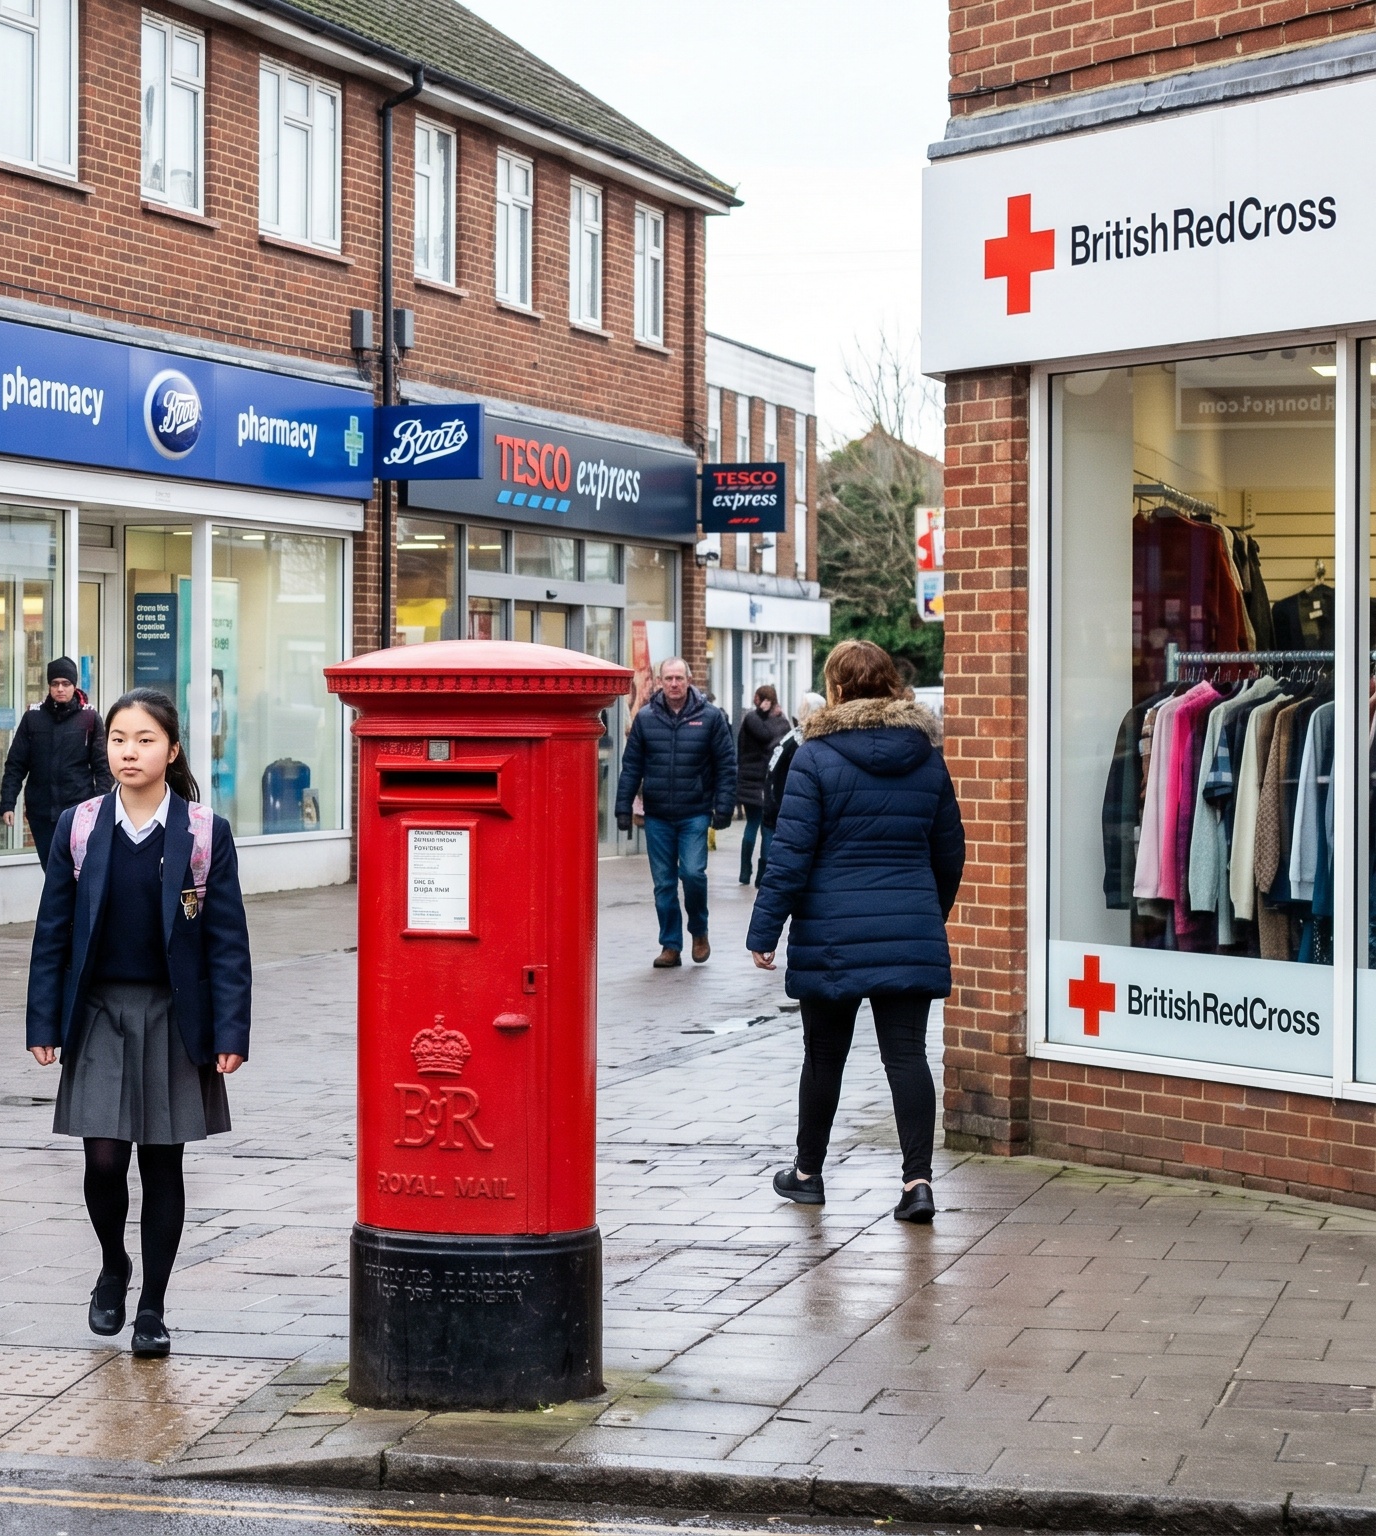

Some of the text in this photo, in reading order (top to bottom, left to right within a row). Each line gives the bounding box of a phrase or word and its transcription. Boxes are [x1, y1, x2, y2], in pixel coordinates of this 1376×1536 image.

[1071, 196, 1337, 266] BritishRedCross
[2, 365, 104, 426] pharmacy
[238, 405, 318, 458] pharmacy
[383, 419, 469, 465] Boots
[494, 434, 641, 511] TESCO express
[713, 471, 777, 486] TESCO
[713, 493, 777, 511] express
[1128, 984, 1321, 1036] BritishRedCross
[378, 1171, 516, 1199] ROYAL MAIL
